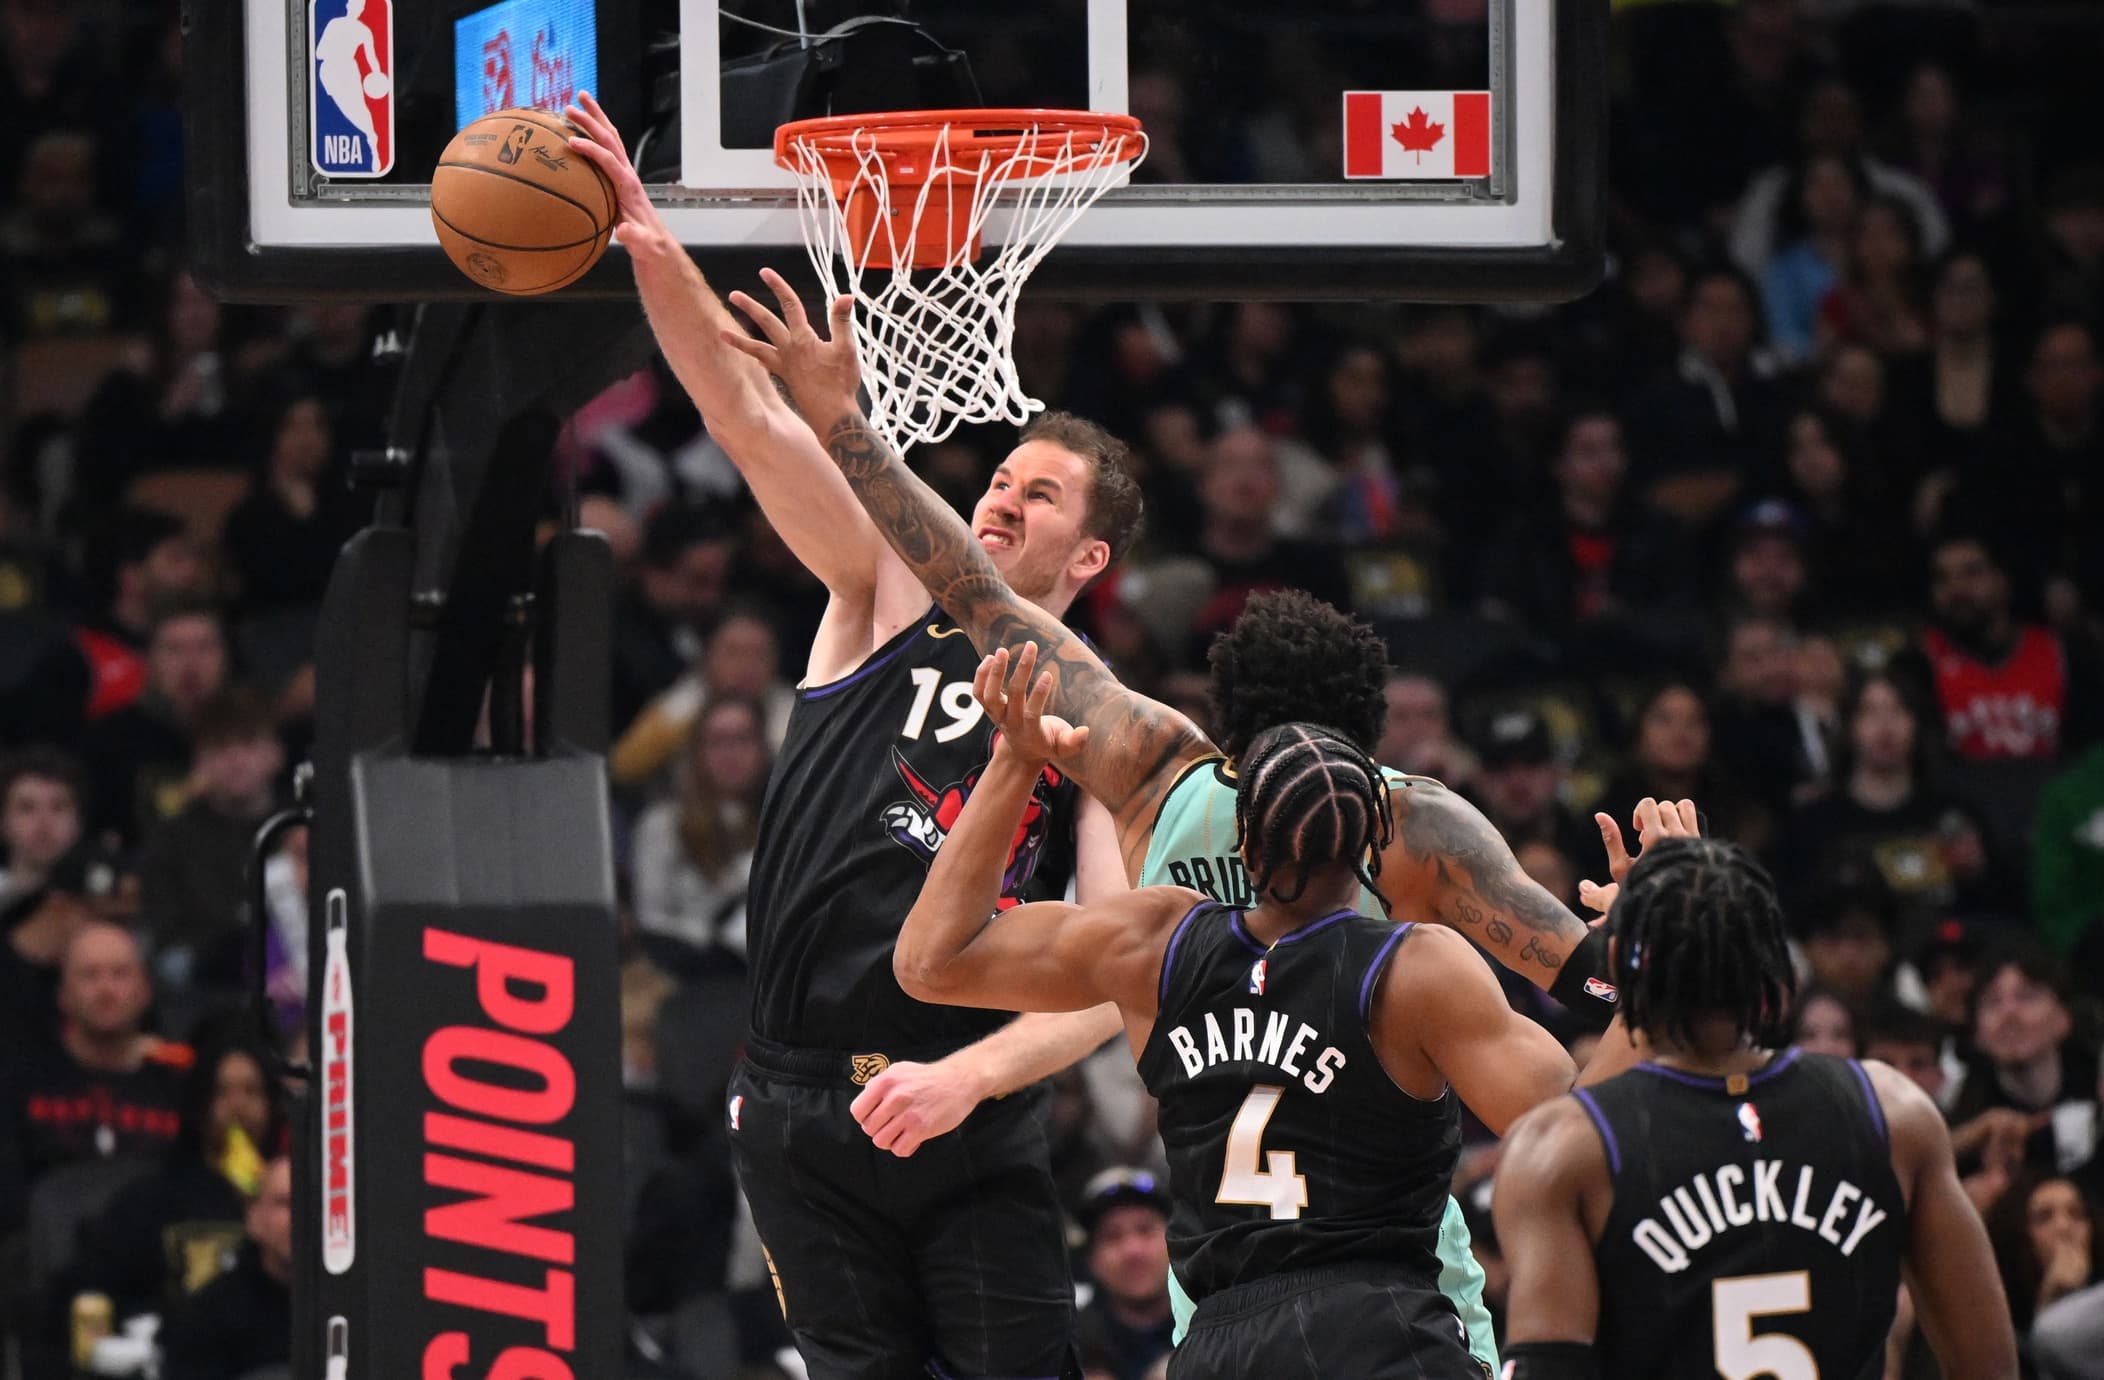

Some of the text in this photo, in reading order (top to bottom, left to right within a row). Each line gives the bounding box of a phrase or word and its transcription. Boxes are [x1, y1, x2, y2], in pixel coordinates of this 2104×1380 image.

[324, 135, 363, 164] NBA
[902, 666, 985, 743] 19
[1168, 1008, 1346, 1094] BARNES
[328, 1011, 348, 1238] PRIME
[1215, 1083, 1309, 1220] 4
[1632, 1159, 1887, 1273] QUICKLEY
[1711, 1269, 1821, 1380] 5
